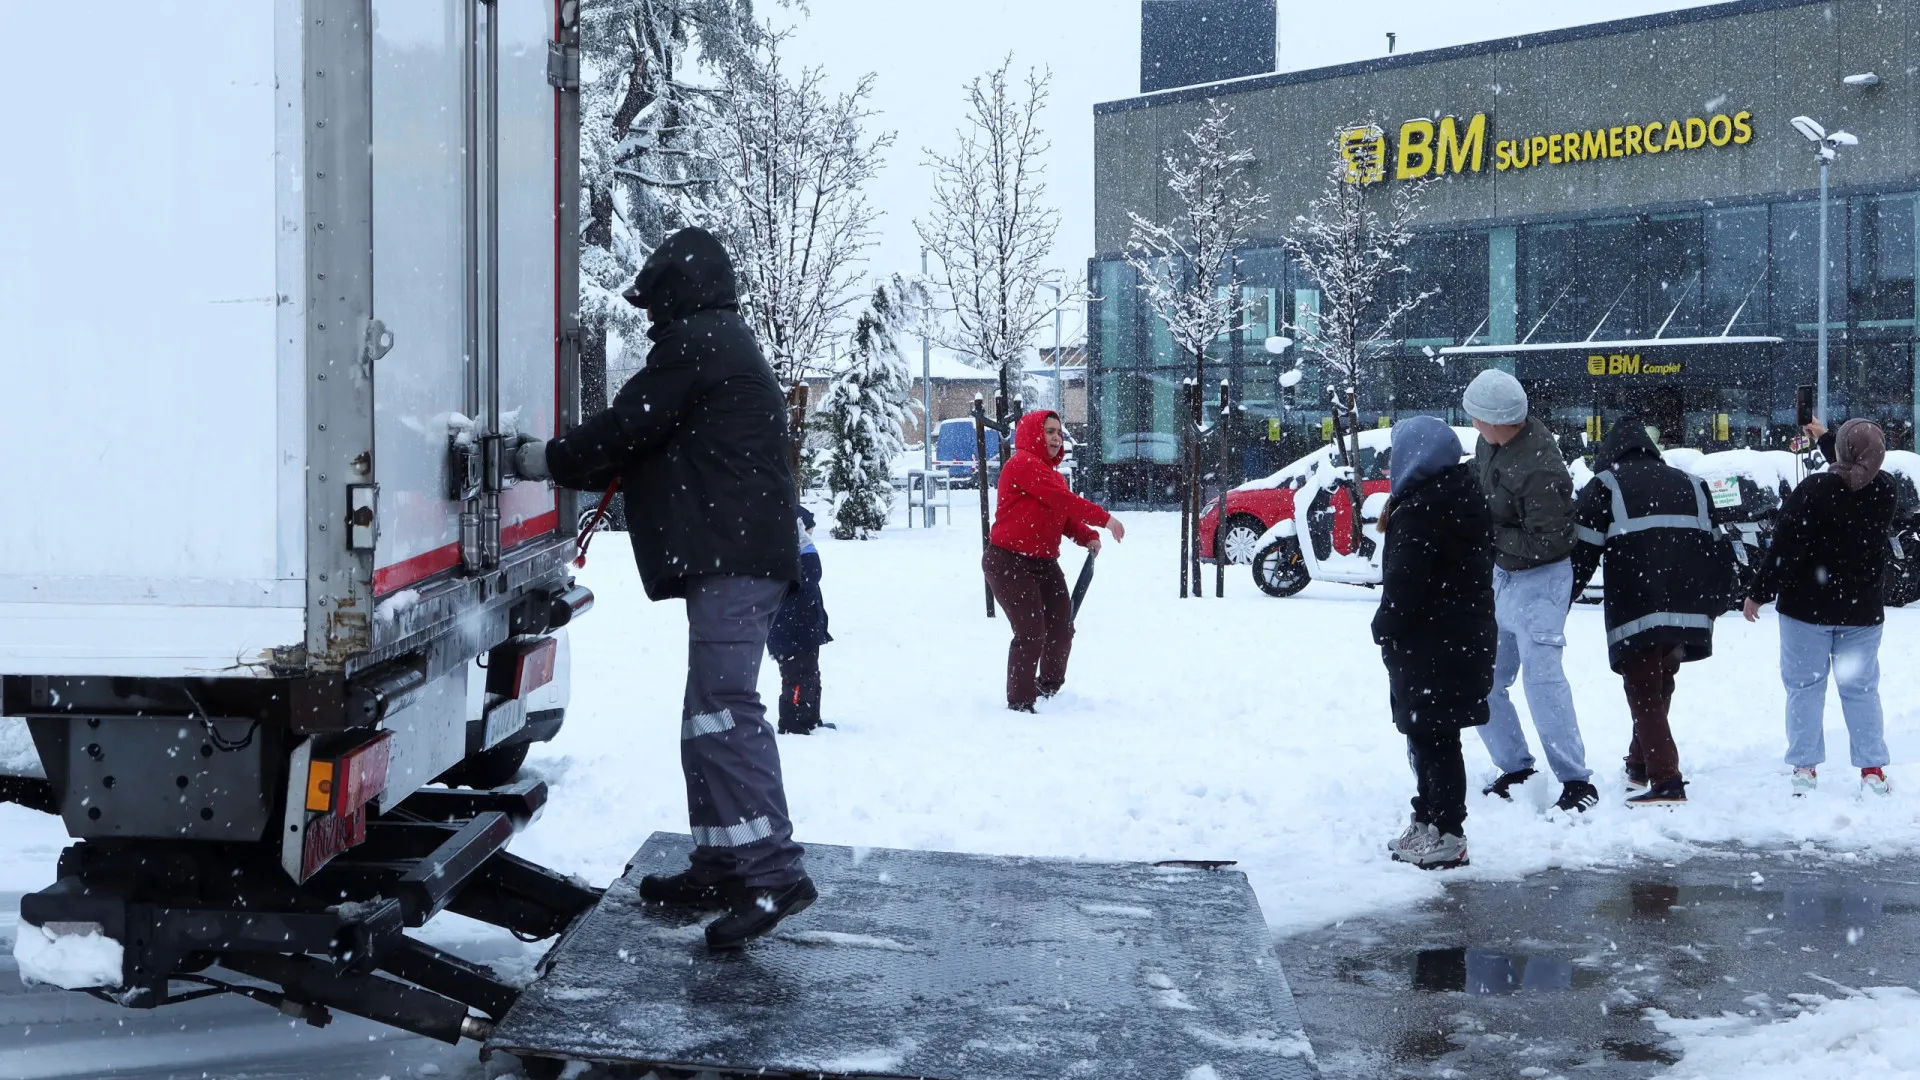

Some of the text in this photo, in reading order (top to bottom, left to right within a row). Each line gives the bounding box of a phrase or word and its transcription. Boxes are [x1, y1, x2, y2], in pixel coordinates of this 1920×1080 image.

[1396, 110, 1752, 180] BM SUPERMERCADOS
[1608, 354, 1681, 375] BM Complet
